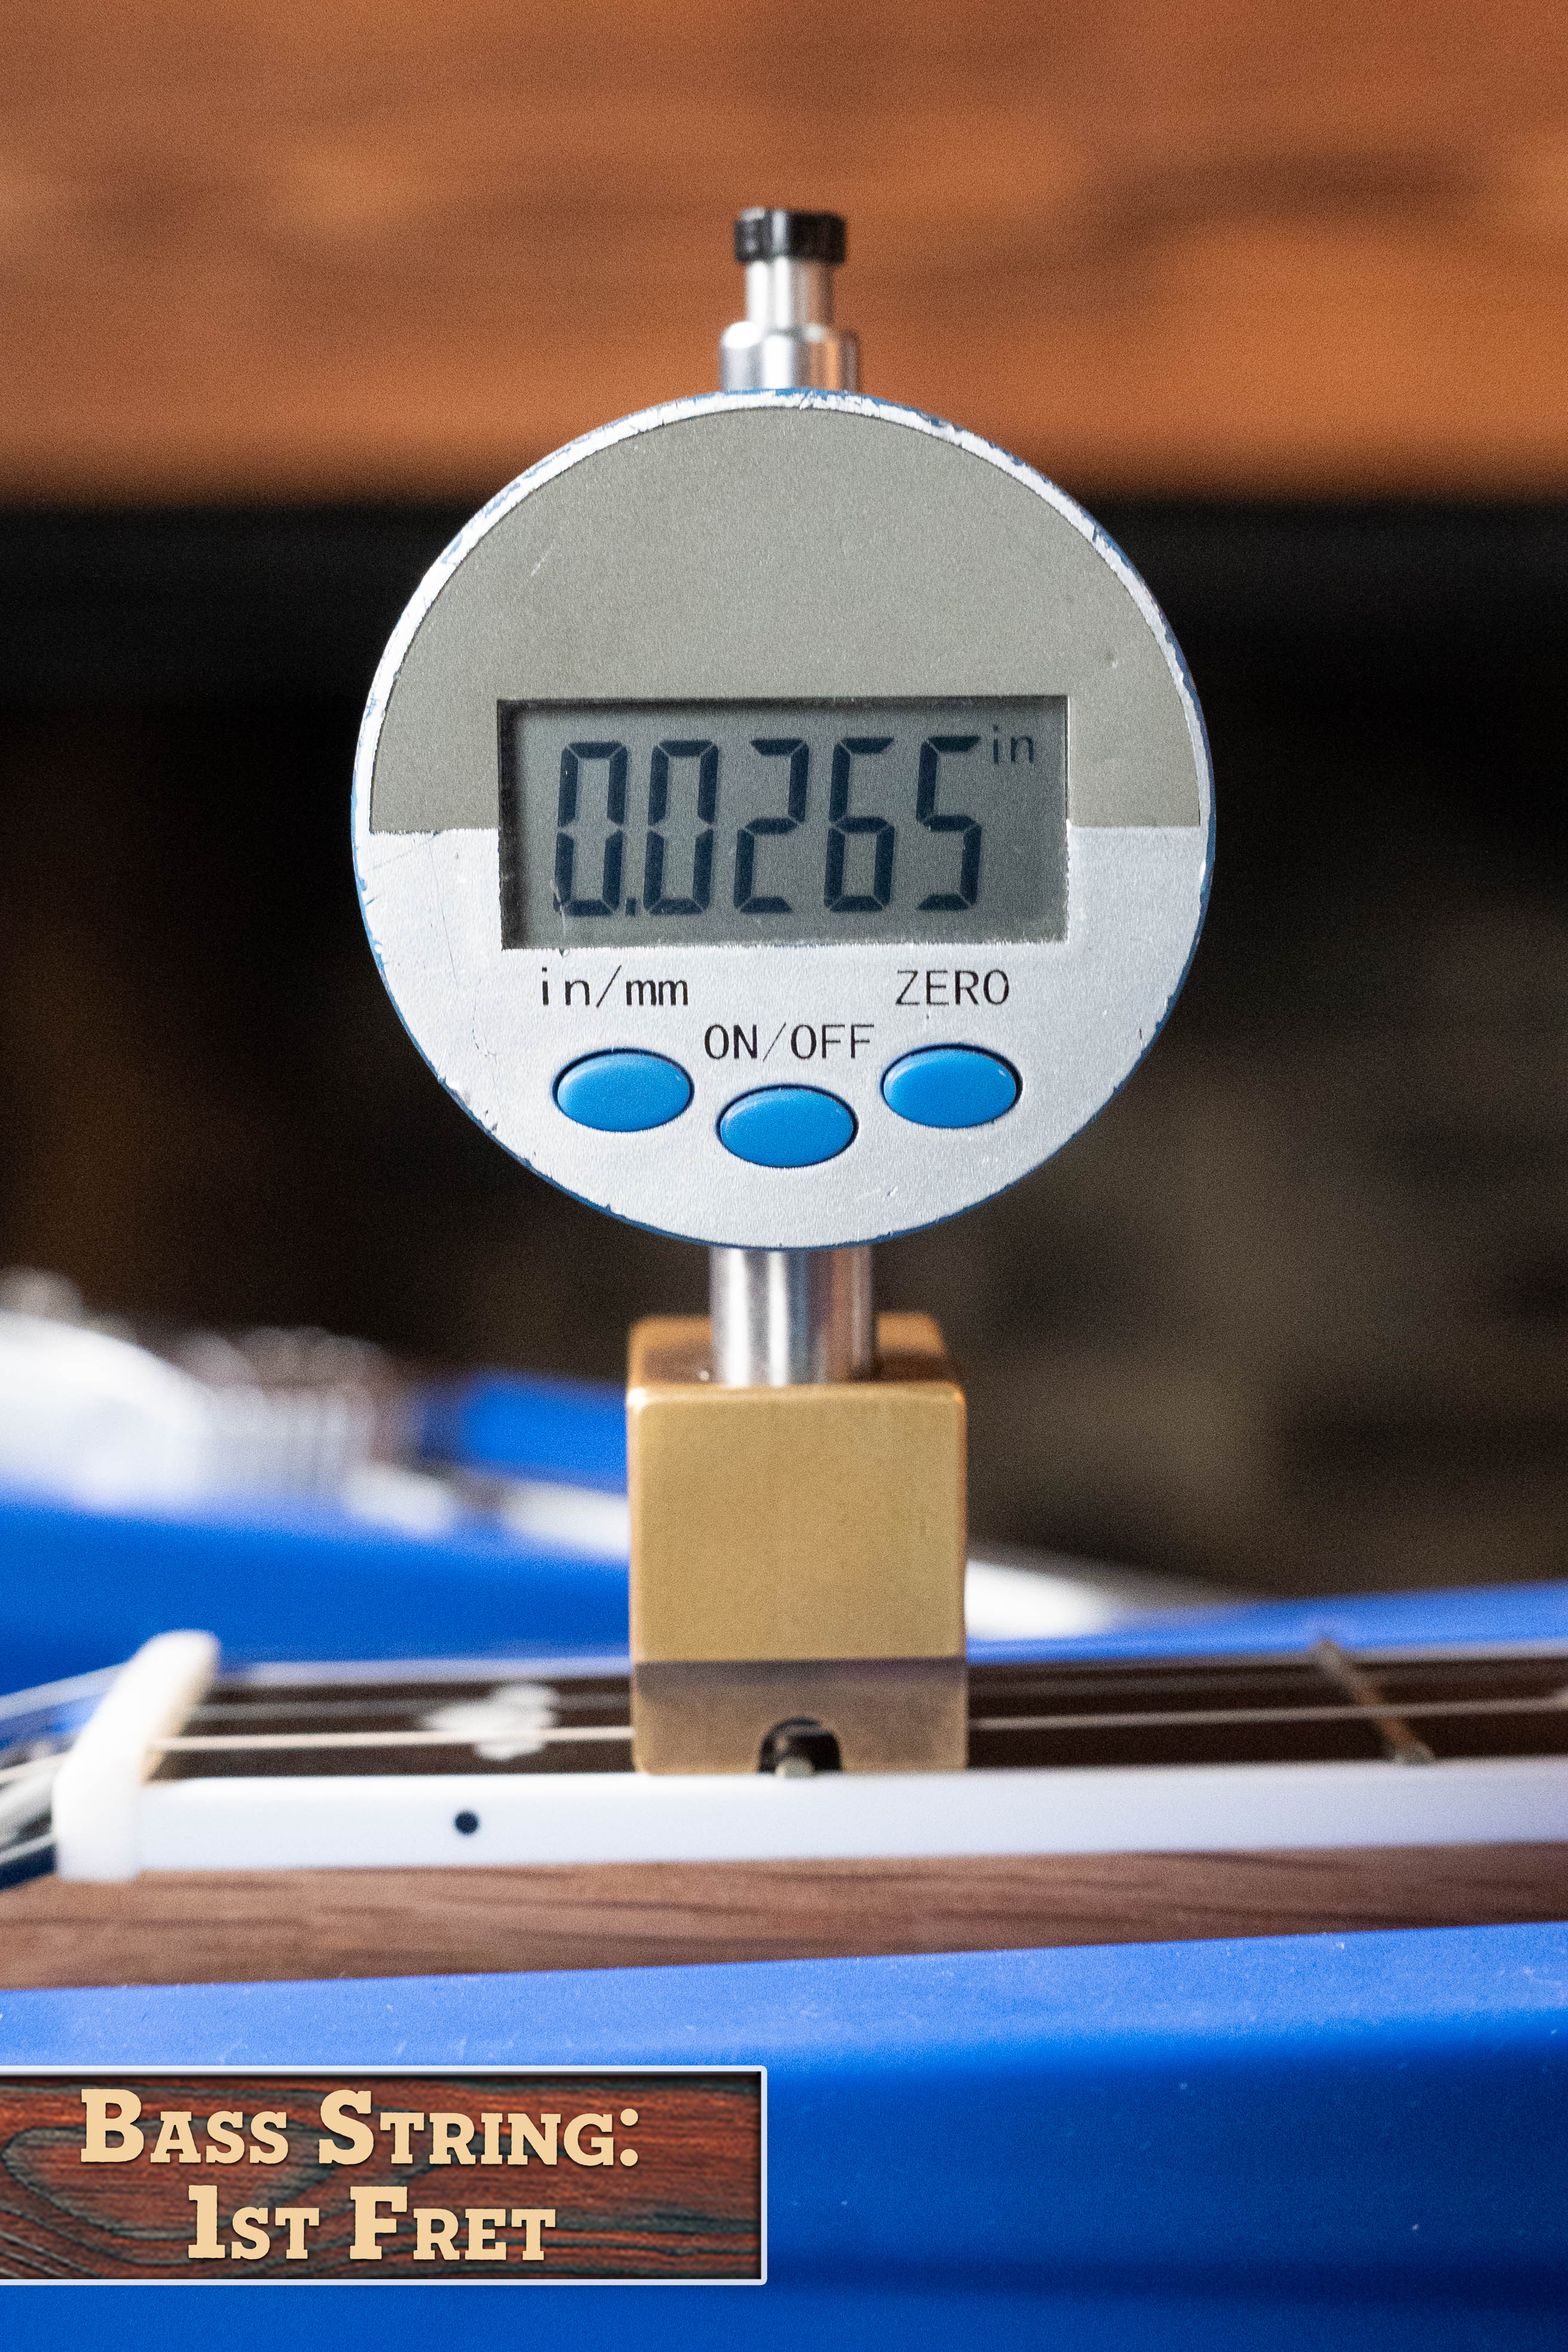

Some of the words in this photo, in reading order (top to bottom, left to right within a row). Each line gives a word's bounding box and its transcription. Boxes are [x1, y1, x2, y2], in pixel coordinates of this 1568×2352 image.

[553, 736, 982, 918] 0.0265
[992, 725, 1036, 765] in
[541, 965, 689, 1008] in/mm
[895, 969, 1010, 1006] ZERO
[704, 1022, 875, 1062] ON/OFF
